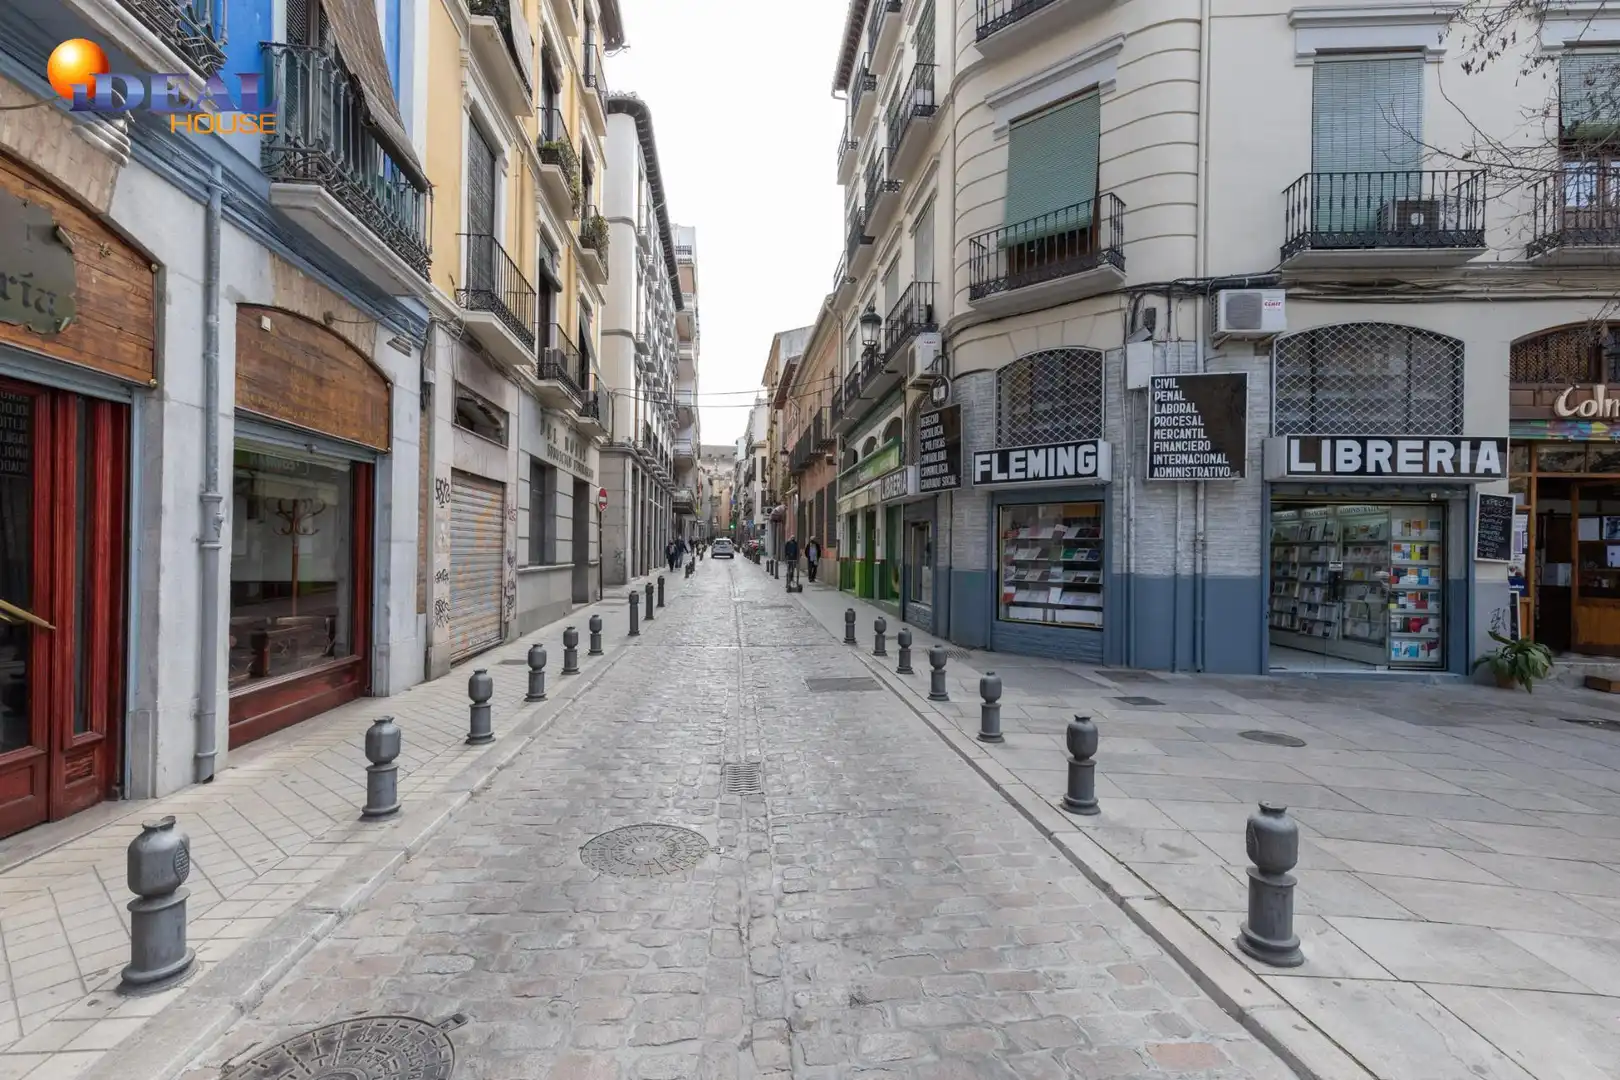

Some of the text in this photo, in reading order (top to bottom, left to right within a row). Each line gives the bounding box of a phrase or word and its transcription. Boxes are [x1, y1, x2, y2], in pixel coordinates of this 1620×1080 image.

[1154, 378, 1179, 389] CIVIL
[1154, 390, 1186, 402] PENAL
[1154, 402, 1199, 415] LABORAL
[1154, 415, 1205, 427] PROCESAL
[1153, 428, 1208, 440] MERCANTIL
[1153, 440, 1211, 452] FINANCIERO
[1153, 453, 1230, 465] INTERNACIONAL
[1290, 439, 1502, 474] LIBRERIA
[974, 444, 1096, 482] FLEMING
[1153, 466, 1231, 478] ADMINISTRATIVO
